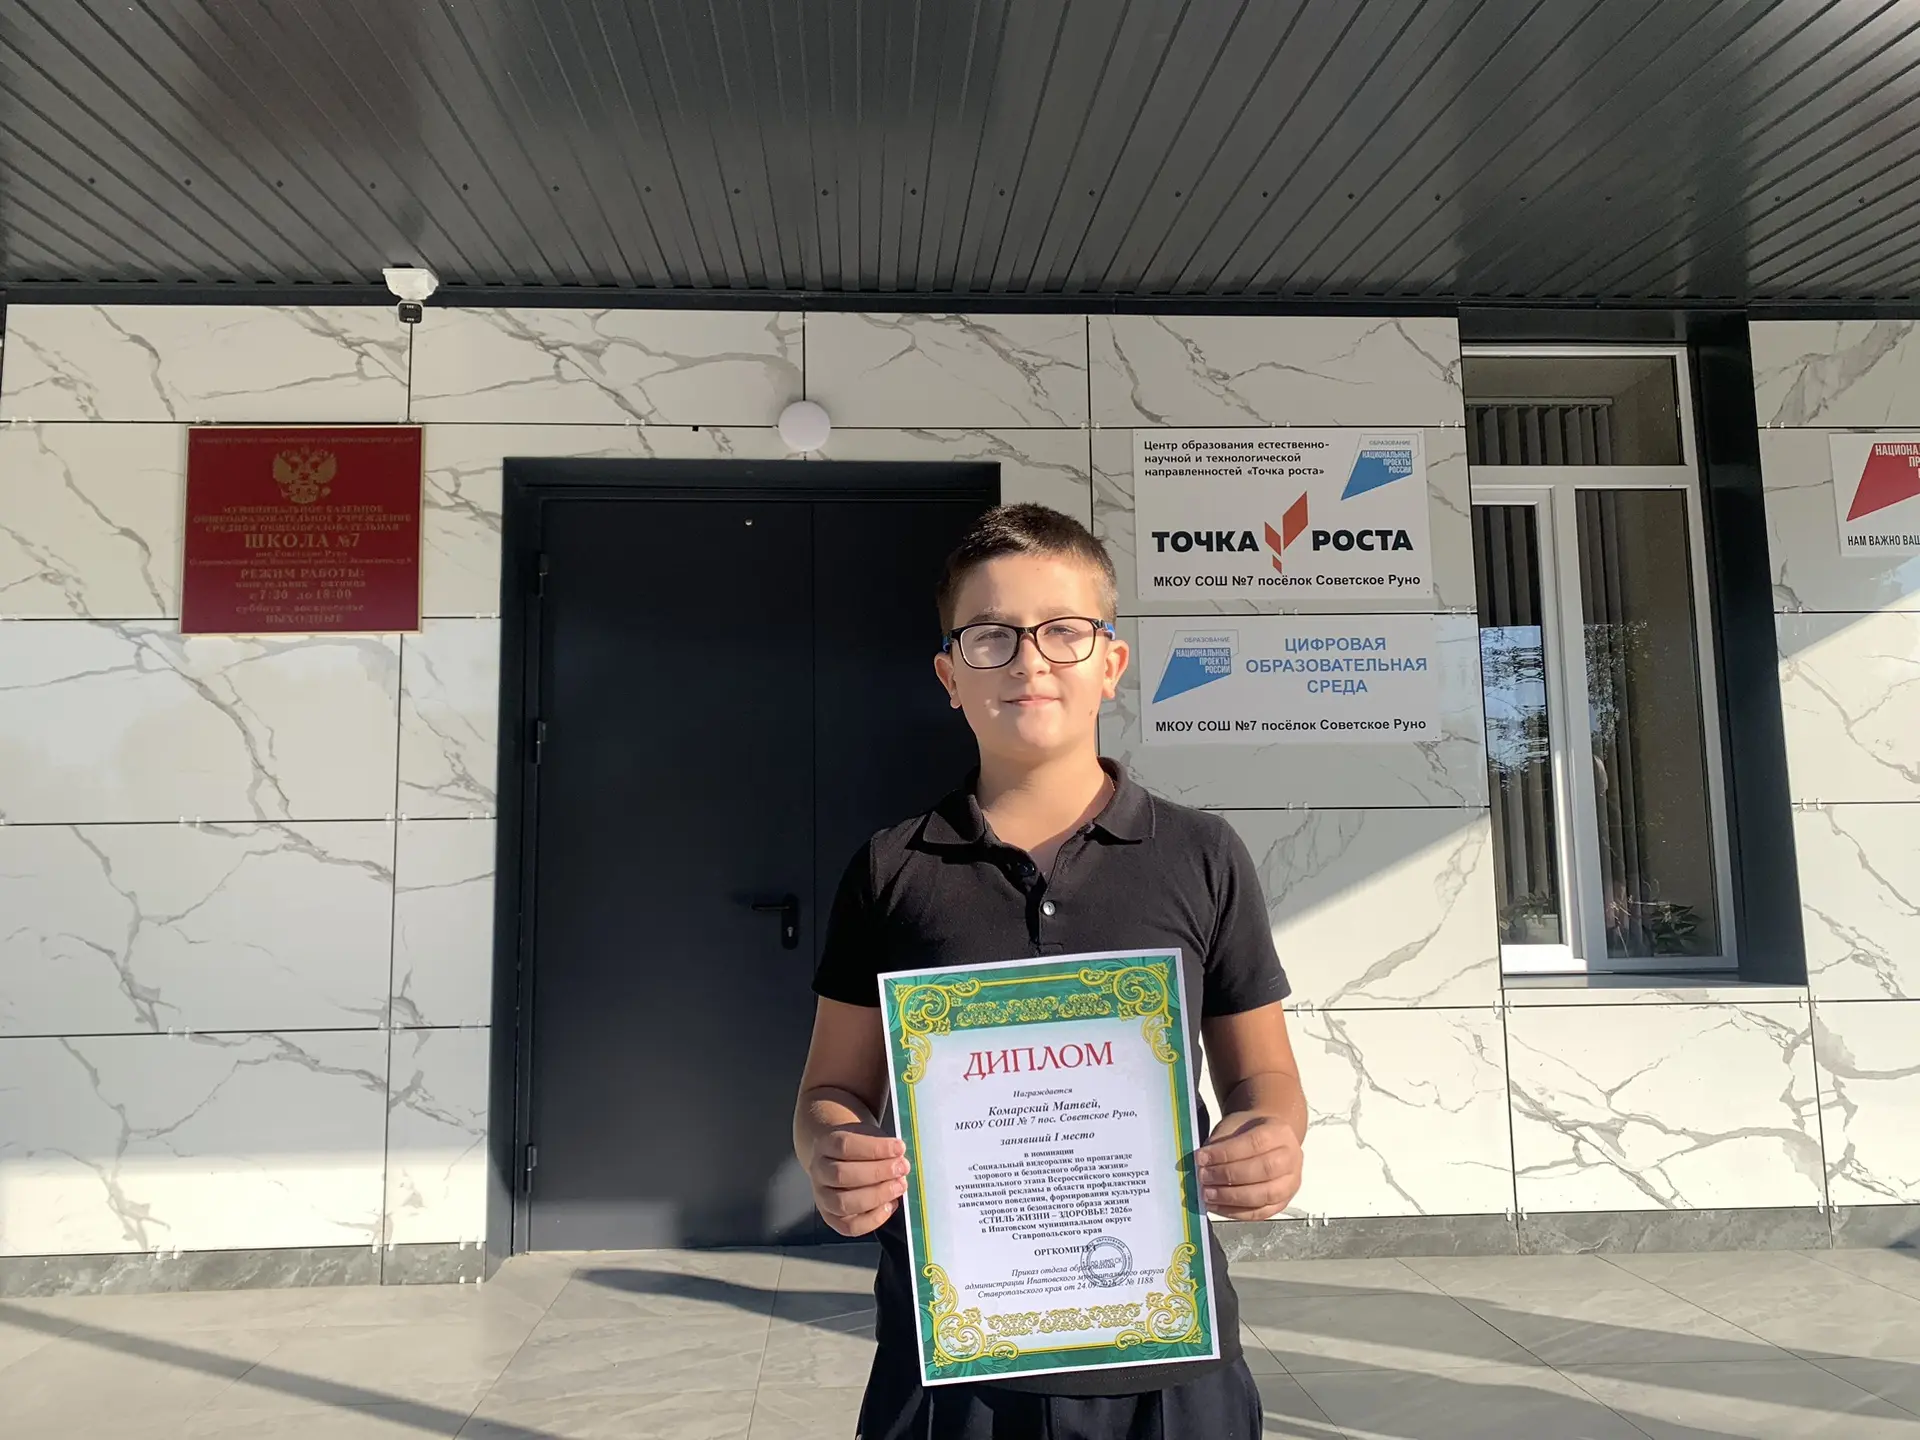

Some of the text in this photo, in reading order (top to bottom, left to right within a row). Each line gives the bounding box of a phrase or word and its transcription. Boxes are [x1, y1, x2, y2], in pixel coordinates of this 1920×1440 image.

[1144, 440, 1330, 451] Центр образования естественно-
[1875, 445, 1920, 456] НАЦИОНА
[1144, 453, 1192, 463] научной
[1206, 452, 1301, 463] технологической
[1362, 451, 1412, 459] НАЦИОНАЛЬНЫЕ
[1383, 459, 1412, 467] ПРОЕКТЫ
[1389, 466, 1413, 474] РОССИИ
[1144, 466, 1324, 478] направленностей «Точка роста»
[244, 533, 361, 549] ШКОЛА №7
[1151, 530, 1413, 553] ТОЧКА РОСТА
[1848, 536, 1867, 546] НАМ
[1869, 535, 1901, 546] ВАЖНО
[240, 568, 365, 579] РЕЖИМ РАБОТЫ:
[1154, 574, 1421, 587] МКОУ СОШ №7 посёлок Советское Руно
[259, 590, 289, 600] 7:30
[315, 590, 352, 600] 18:00
[1284, 637, 1387, 654] ЦИФРОВАЯ
[1175, 648, 1231, 658] НАЦИОНАЛЬНЫЕ
[1199, 657, 1231, 665] ПРОЕКТЫ
[1245, 658, 1428, 673] ОБРАЗОВАТЕЛЬНАЯ
[1205, 665, 1232, 674] РОССИИ
[1307, 679, 1368, 696] СРЕДА
[1155, 719, 1427, 732] МКОУ СОШ №7 посёлок Советское Руно
[963, 1041, 1114, 1081] ДИПЛОМ
[1013, 1087, 1073, 1099] Награждается
[988, 1098, 1101, 1117] Комарский Матвей,
[954, 1109, 1138, 1131] МКОУ СОШ № 7 пос. Советское Руно,
[1000, 1131, 1095, 1146] занявший I место
[1031, 1148, 1074, 1157] номинации
[968, 1160, 1024, 1172] «Социальный
[1026, 1157, 1073, 1167] видеоролик
[1087, 1153, 1133, 1164] пропаганде
[974, 1172, 1013, 1181] здорового
[1021, 1166, 1069, 1177] безопасного
[1070, 1164, 1097, 1174] образа
[1098, 1163, 1129, 1171] жизни»
[955, 1169, 1150, 1191] муниципального этапа Всероссийского конкурса
[960, 1188, 1007, 1200] социальной
[1008, 1186, 1045, 1196] рекламы
[1053, 1183, 1085, 1192] области
[1087, 1179, 1147, 1190] профилактики
[958, 1187, 1150, 1208] зависимого поведения, формирования культуры
[979, 1207, 1018, 1217] здорового
[1027, 1202, 1075, 1213] безопасного
[1076, 1200, 1102, 1209] образа
[1103, 1197, 1130, 1206] жизни
[979, 1216, 1015, 1225] «СТИЛЬ
[1017, 1212, 1050, 1222] ЖИЗНИ
[1059, 1207, 1108, 1218] ЗДОРОВЬЕ!
[1110, 1205, 1133, 1214] 2026»
[988, 1223, 1036, 1234] Ипатовском
[1038, 1218, 1103, 1230] муниципальном
[1105, 1215, 1132, 1225] округе
[1012, 1227, 1102, 1241] Ставропольского края
[1034, 1244, 1097, 1256] ОРГКОМИТЕТ
[964, 1279, 1025, 1291] администрации
[1026, 1275, 1076, 1286] Ипатовского
[1139, 1267, 1165, 1277] округа
[1011, 1269, 1039, 1278] Приказ
[1040, 1266, 1067, 1275] отдела
[977, 1286, 1043, 1299] Ставропольского
[1045, 1285, 1063, 1295] края
[1125, 1278, 1135, 1287] №
[1137, 1276, 1154, 1285] 1188
